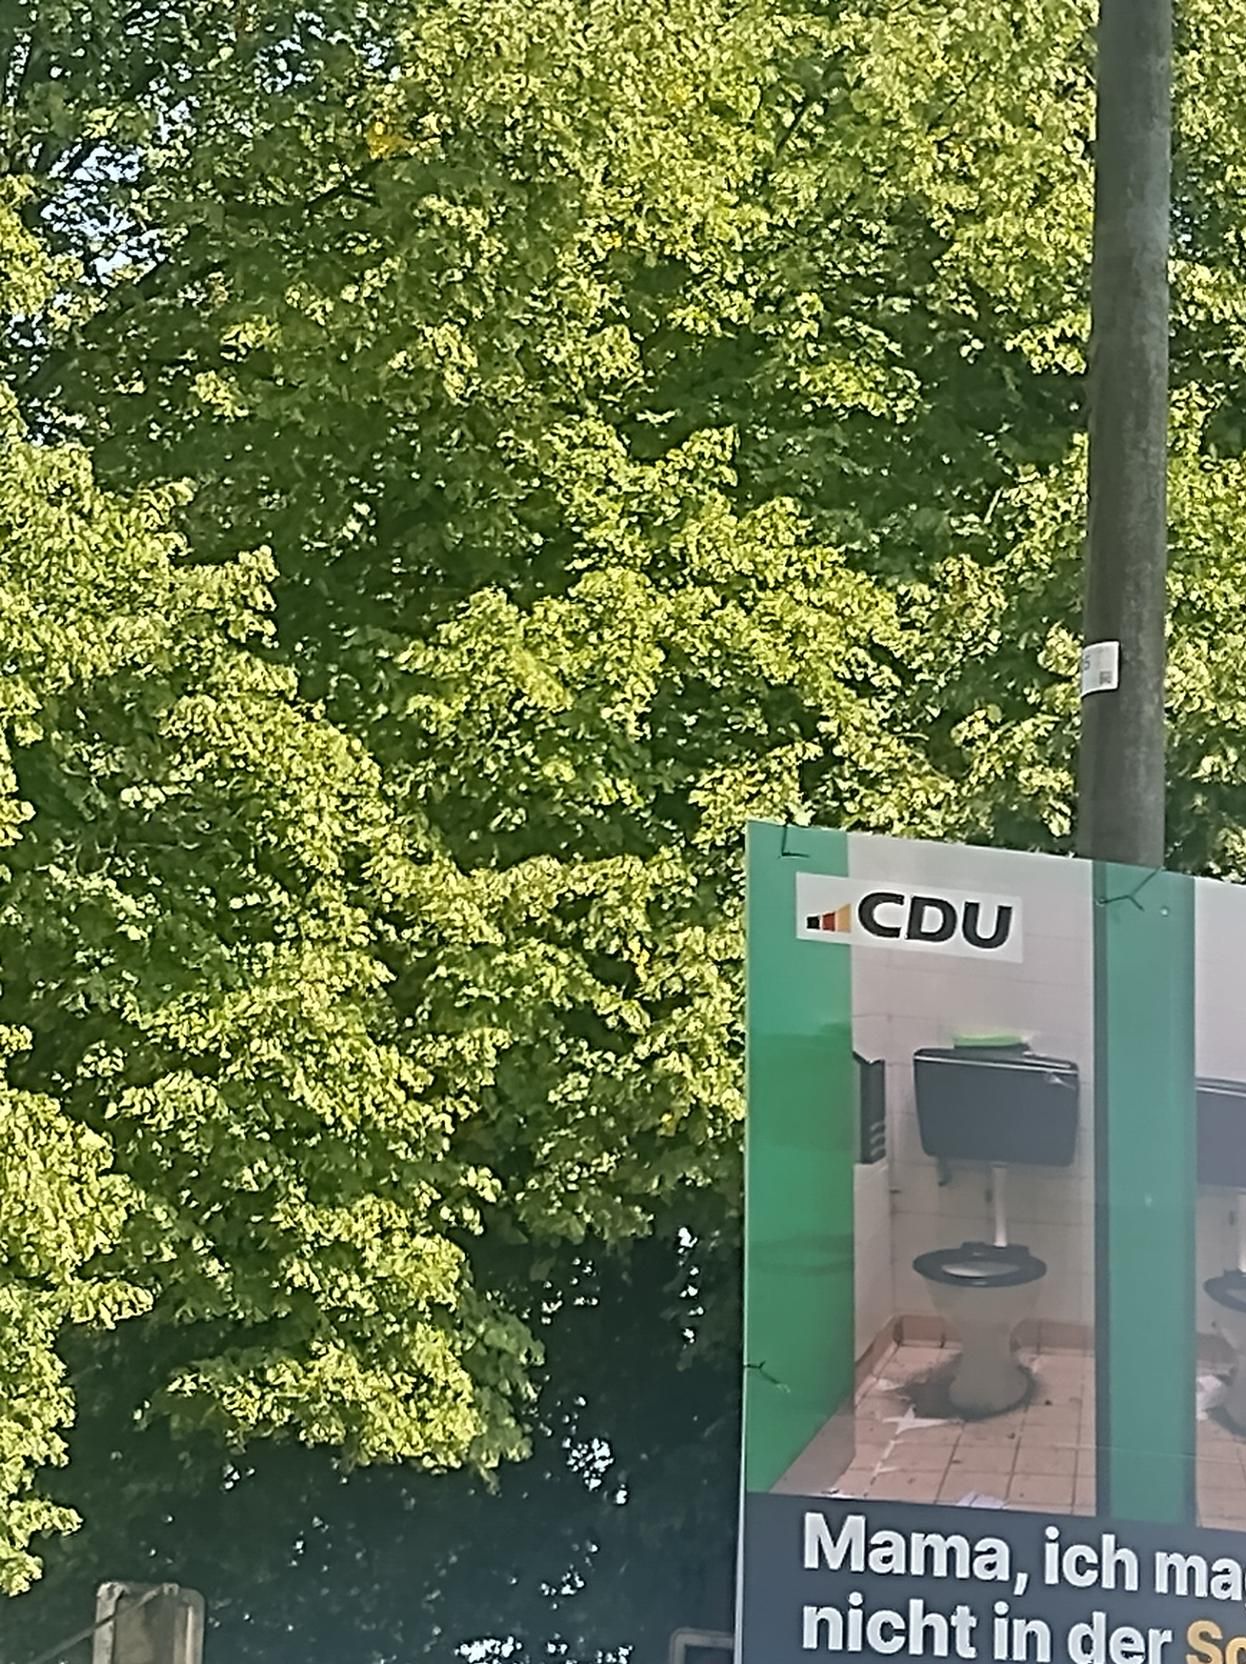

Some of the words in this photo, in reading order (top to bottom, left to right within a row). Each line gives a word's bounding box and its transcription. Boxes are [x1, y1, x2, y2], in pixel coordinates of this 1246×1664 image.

[857, 891, 1013, 950] CDU
[803, 1511, 1030, 1595] Mama,
[1044, 1526, 1139, 1592] ich
[802, 1592, 977, 1659] nicht
[993, 1602, 1052, 1664] in
